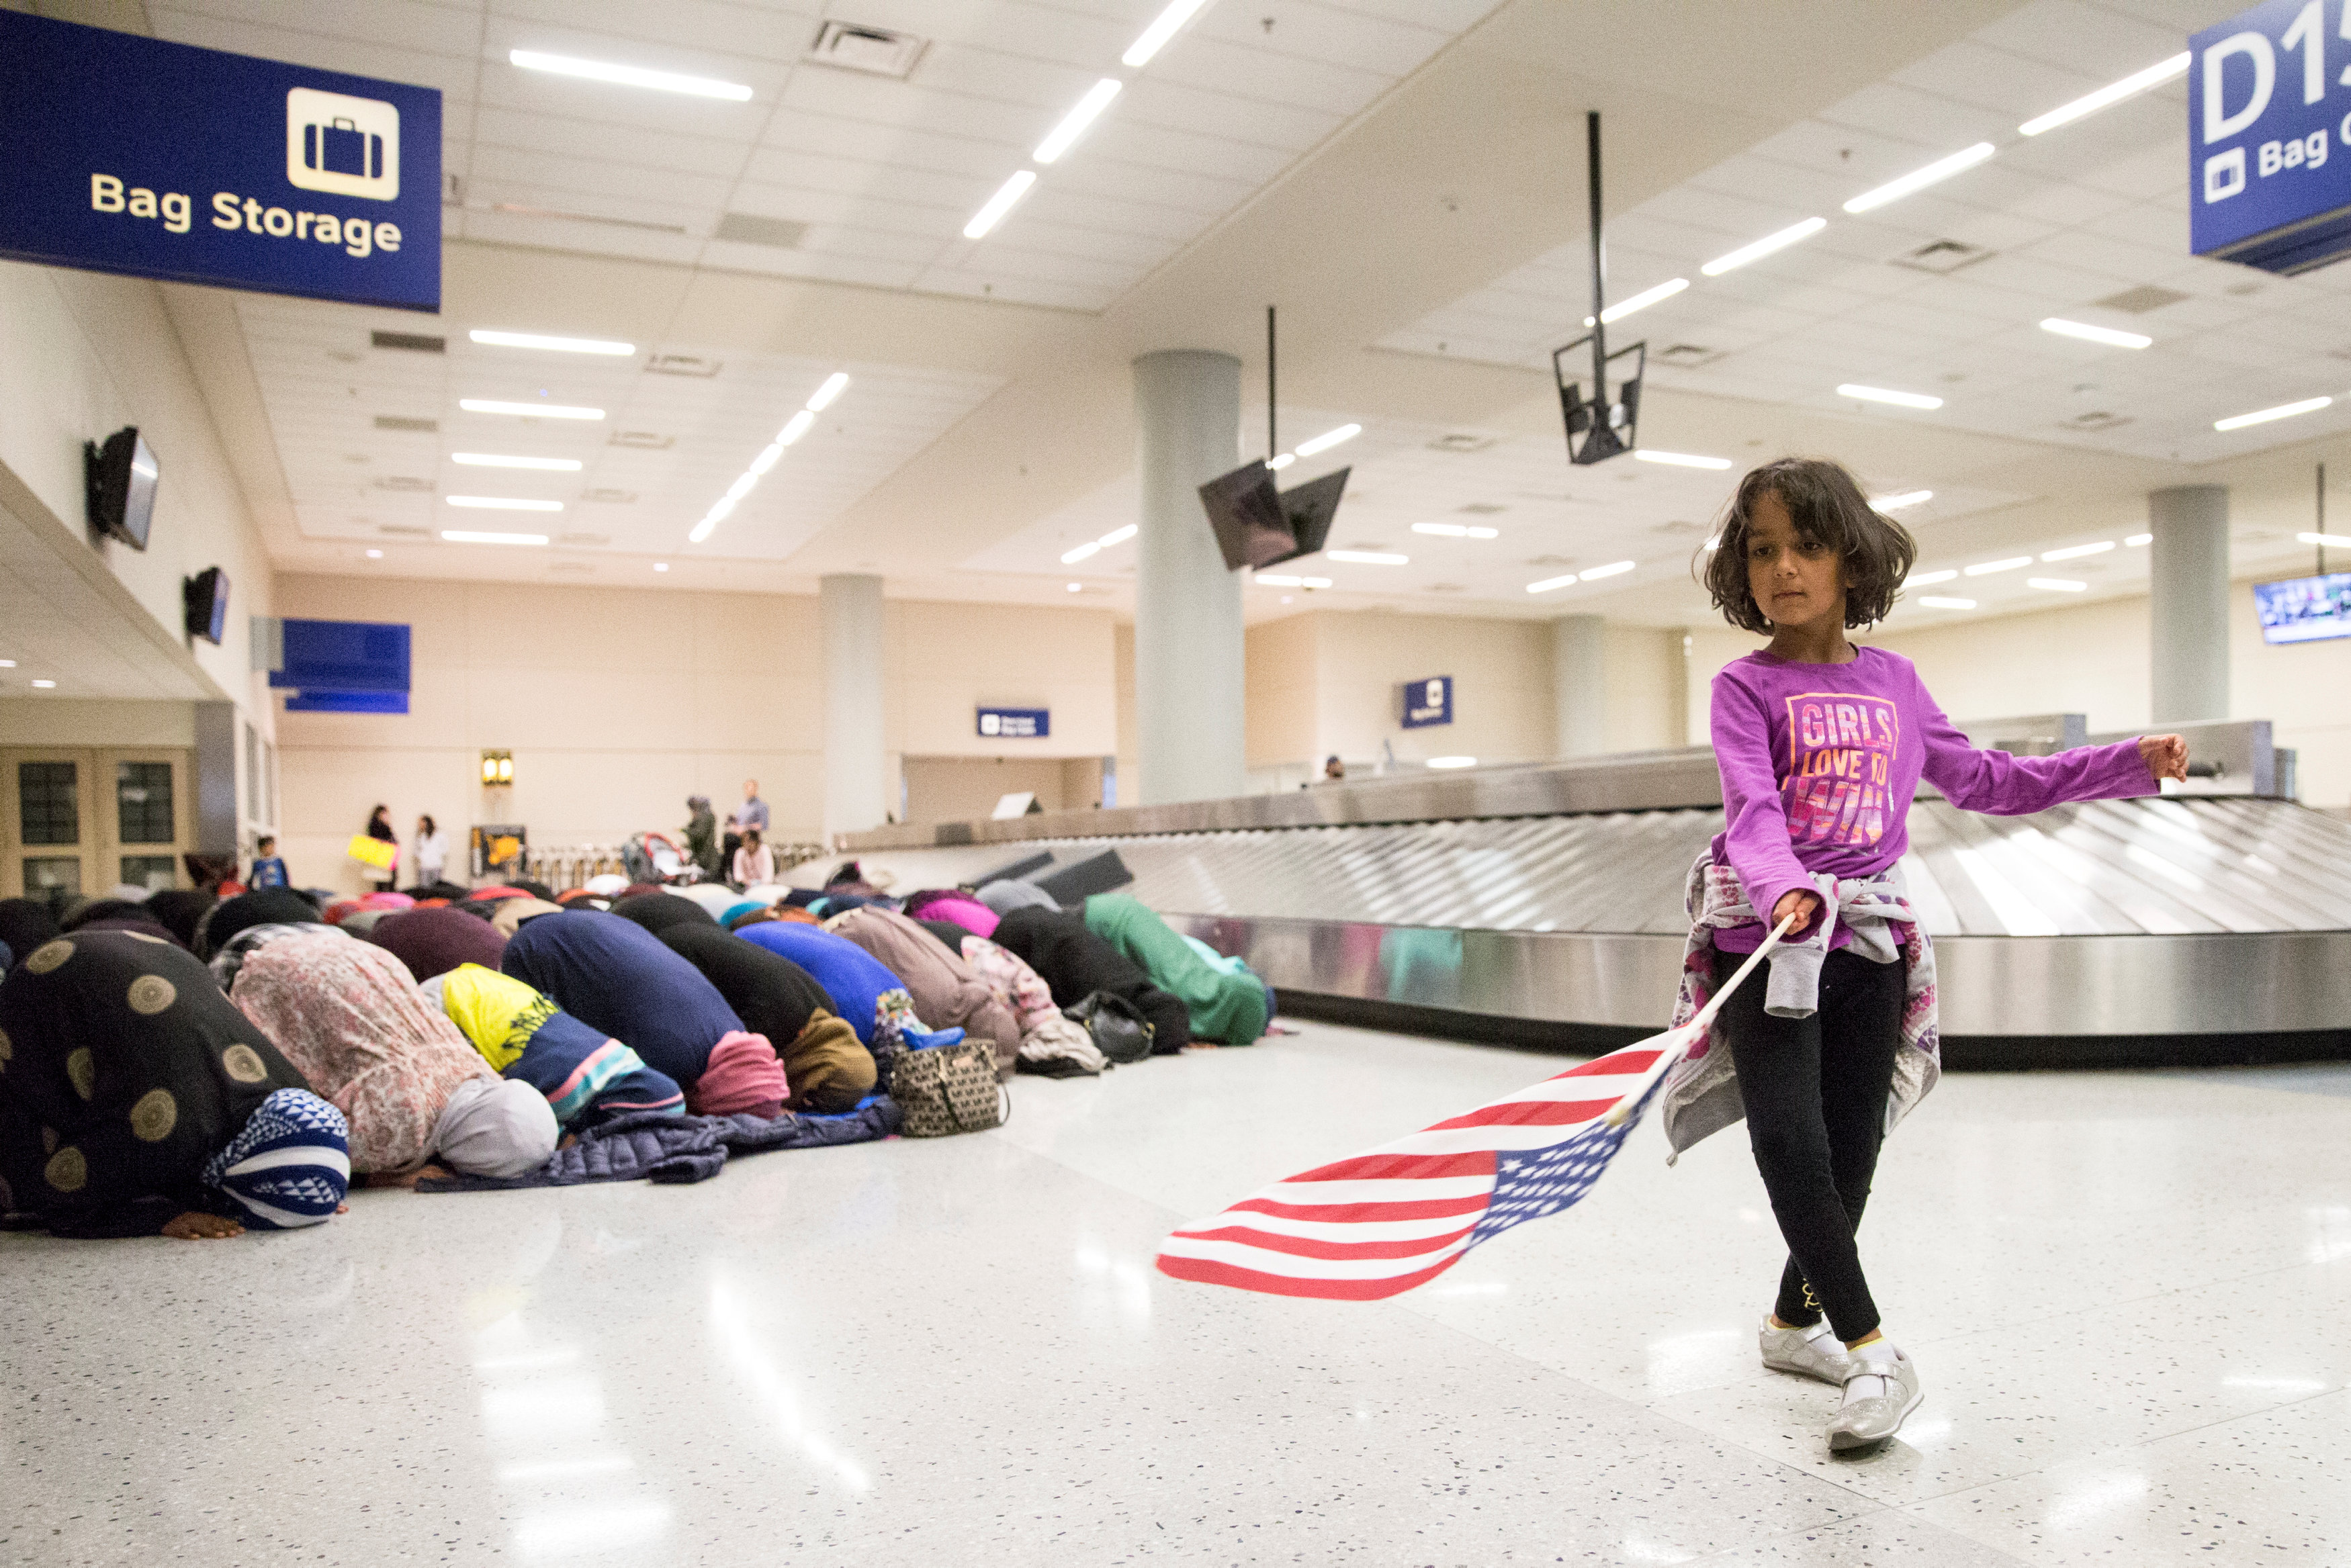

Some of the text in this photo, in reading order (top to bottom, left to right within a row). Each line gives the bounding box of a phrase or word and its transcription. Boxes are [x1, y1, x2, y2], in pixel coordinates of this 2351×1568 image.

[2203, 0, 2351, 145] D1
[2258, 129, 2328, 177] Bag
[91, 173, 402, 258] Bag Storage
[1802, 704, 1893, 750] GIRLS
[1800, 748, 1888, 786] LOVE TO
